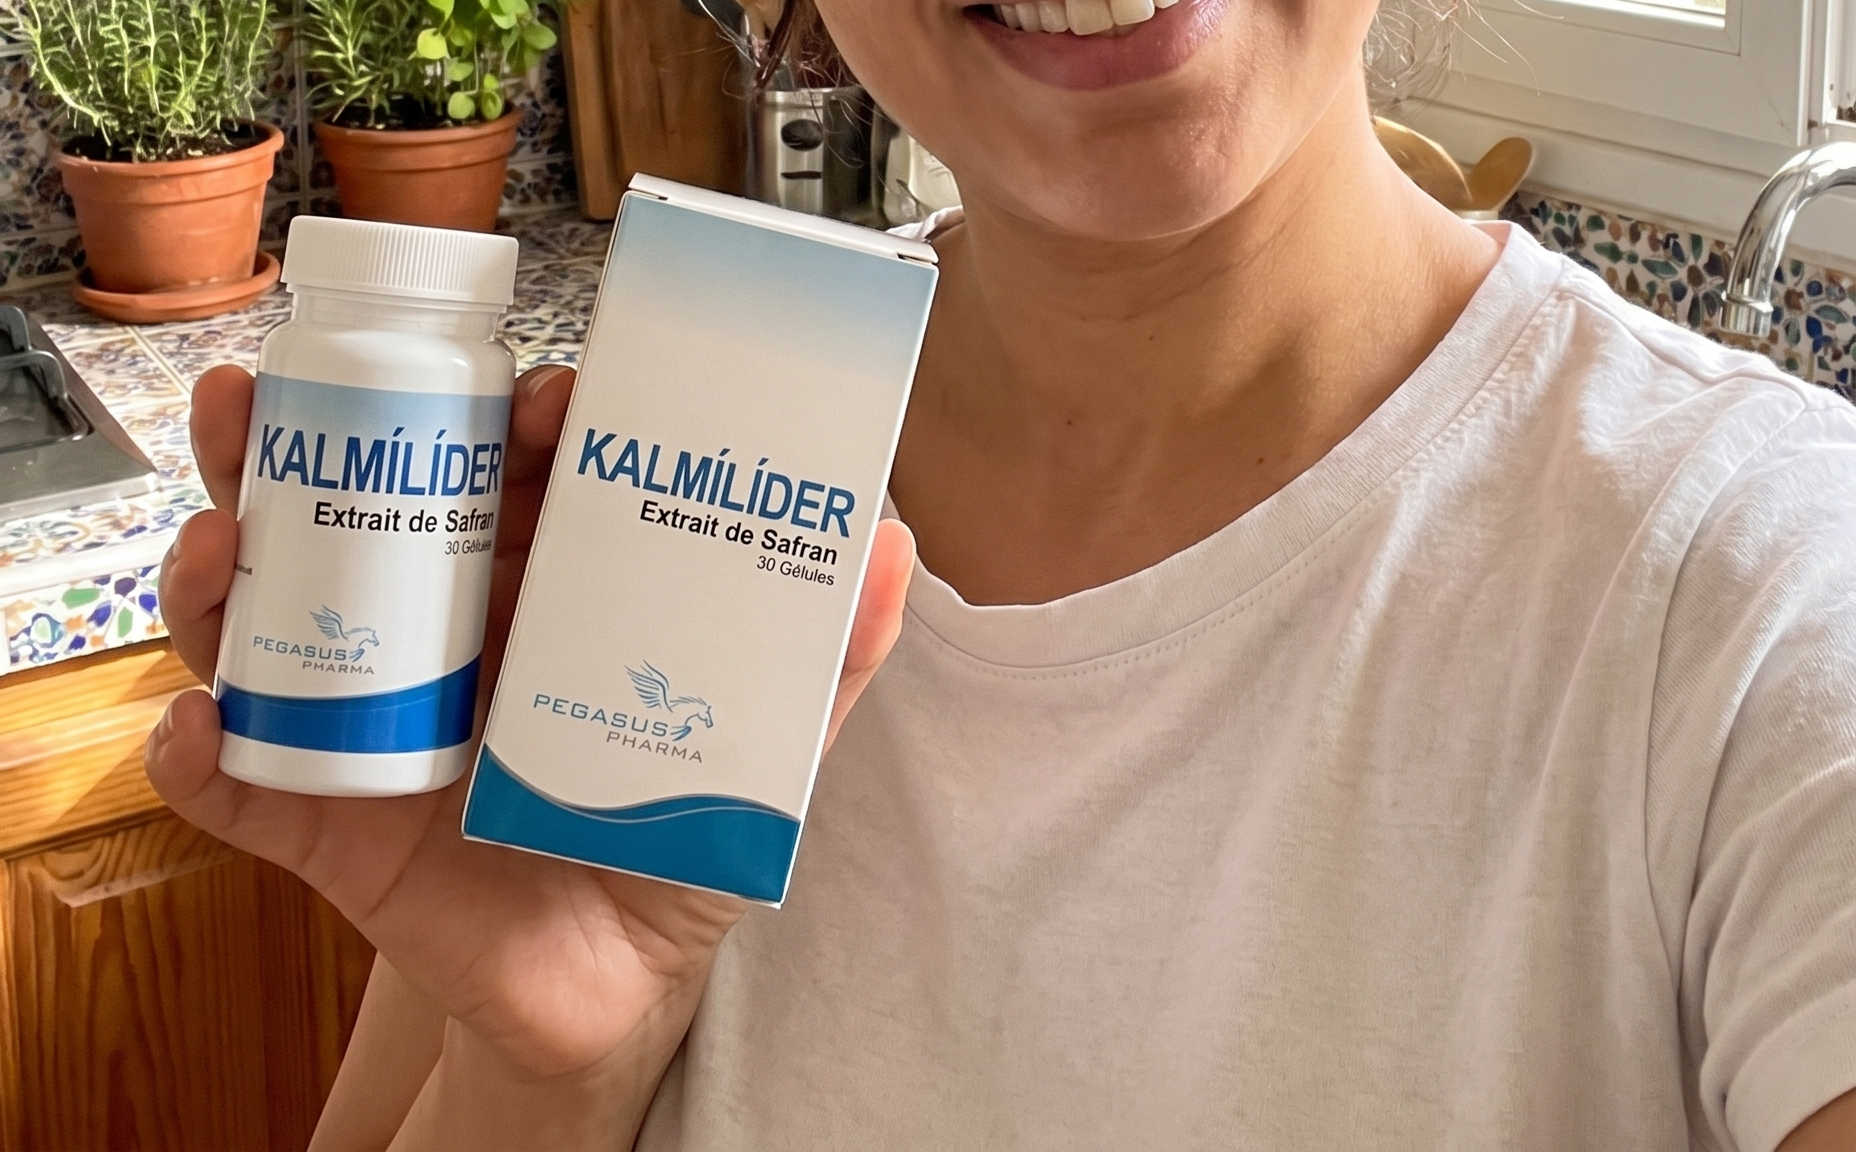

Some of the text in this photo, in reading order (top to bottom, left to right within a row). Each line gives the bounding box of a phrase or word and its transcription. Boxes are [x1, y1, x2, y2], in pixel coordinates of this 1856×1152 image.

[257, 424, 502, 496] KALMÍLÍDER
[577, 428, 855, 538] KALMÍLÍDER
[313, 501, 494, 533] Extrait de Safran
[640, 500, 838, 565] Extrait de Safran
[445, 540, 460, 555] 30
[756, 555, 835, 586] 30 Gélules
[253, 636, 347, 661] PEGASUS
[533, 694, 669, 737] PEGASUS
[606, 731, 702, 763] PHARMA
